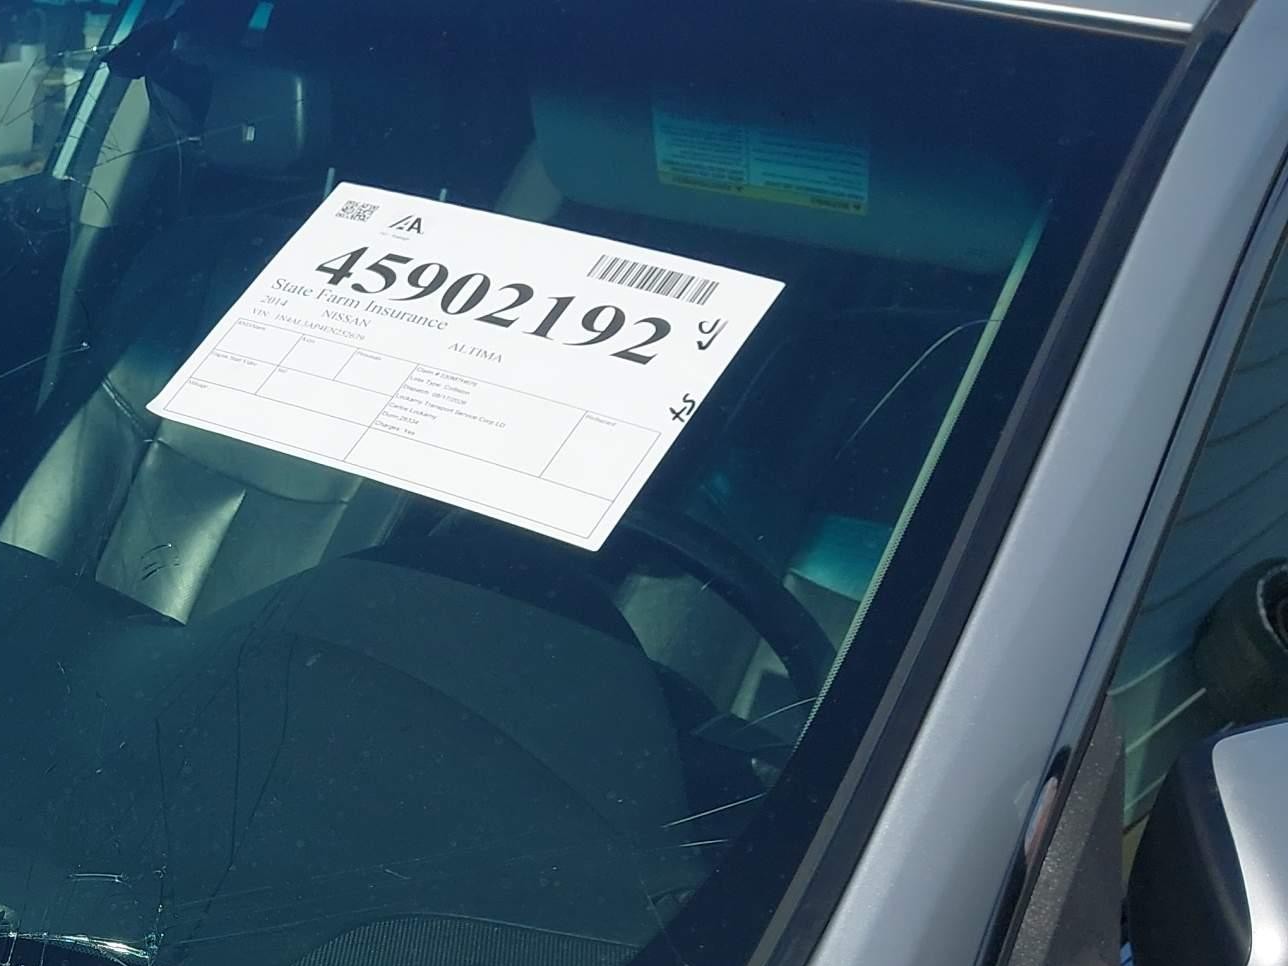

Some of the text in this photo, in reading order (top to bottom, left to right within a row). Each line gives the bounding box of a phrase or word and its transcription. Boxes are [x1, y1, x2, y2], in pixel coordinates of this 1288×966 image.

[261, 296, 501, 363] 2014 NISSAN ALTIMA
[272, 279, 448, 330] State Farm Insurance
[316, 247, 671, 365] 45902192
